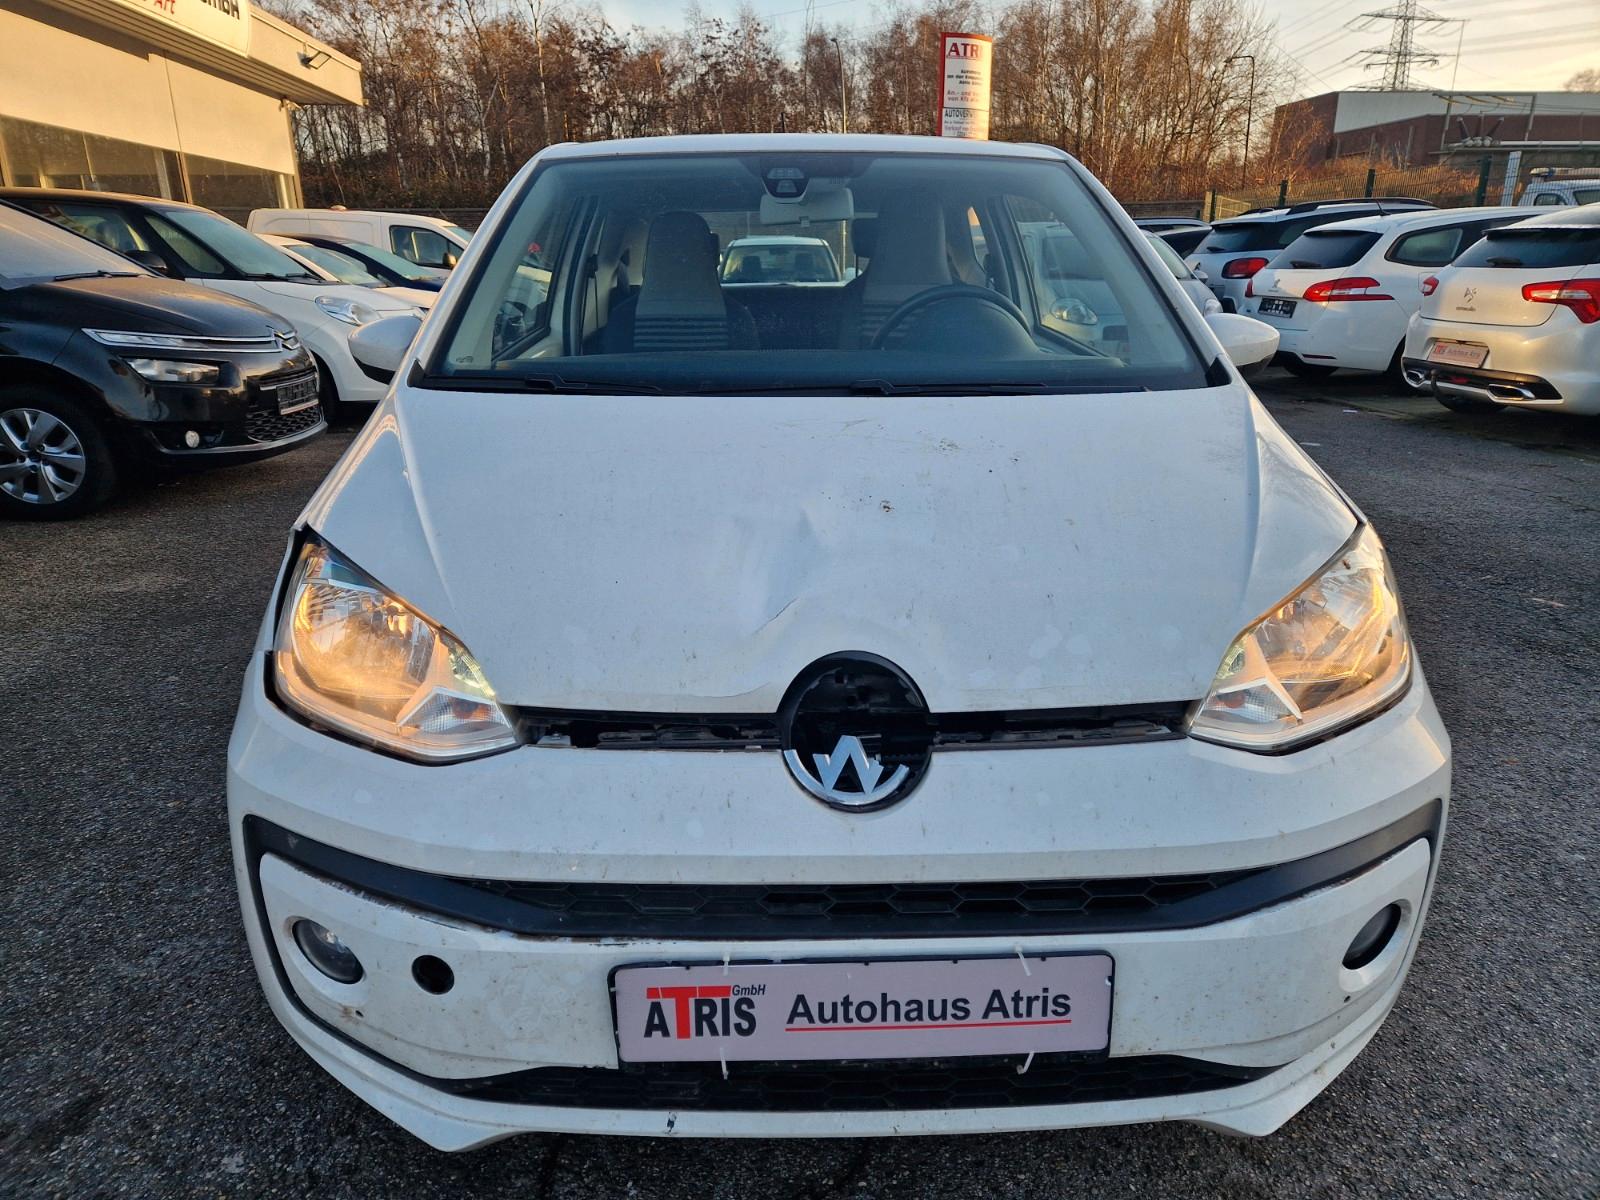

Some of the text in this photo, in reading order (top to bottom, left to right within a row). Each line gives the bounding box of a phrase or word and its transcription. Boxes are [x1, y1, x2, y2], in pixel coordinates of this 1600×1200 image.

[200, 0, 240, 20] mbH
[732, 984, 766, 997] GmbH
[643, 985, 757, 1040] ATRIS
[786, 987, 1072, 1025] Autohaus Atris
